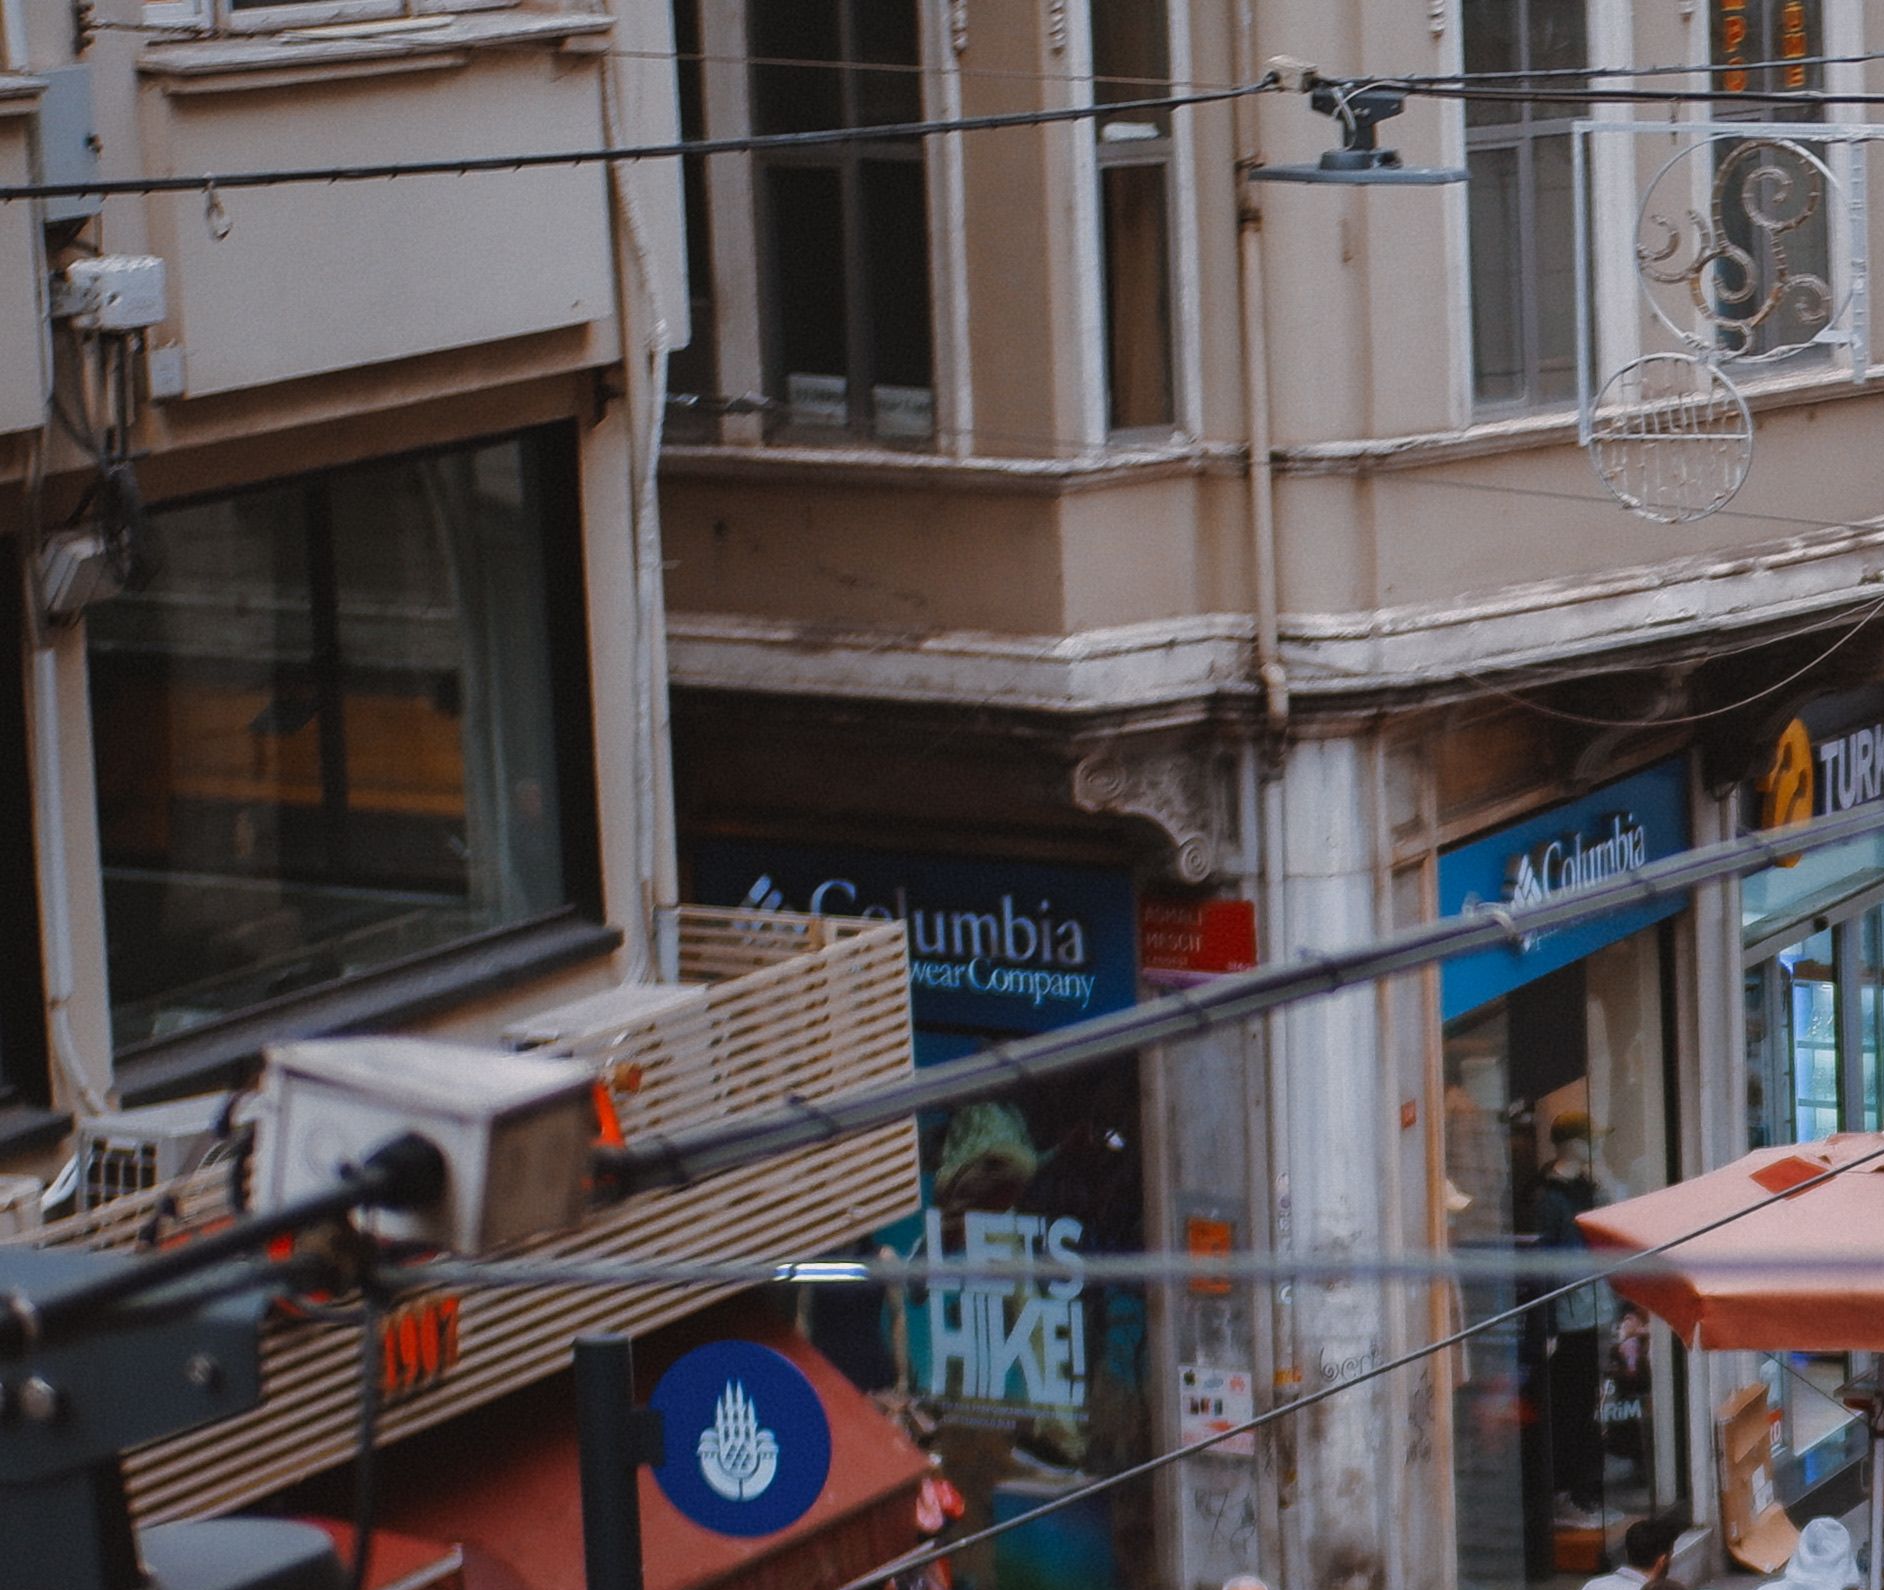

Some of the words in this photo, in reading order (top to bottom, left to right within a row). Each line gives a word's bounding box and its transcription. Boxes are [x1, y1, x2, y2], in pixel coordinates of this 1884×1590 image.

[1542, 813, 1645, 900] Columbia
[968, 957, 1095, 1008] Company
[926, 1206, 1085, 1300] LET'S
[928, 1288, 1087, 1407] HIKE!
